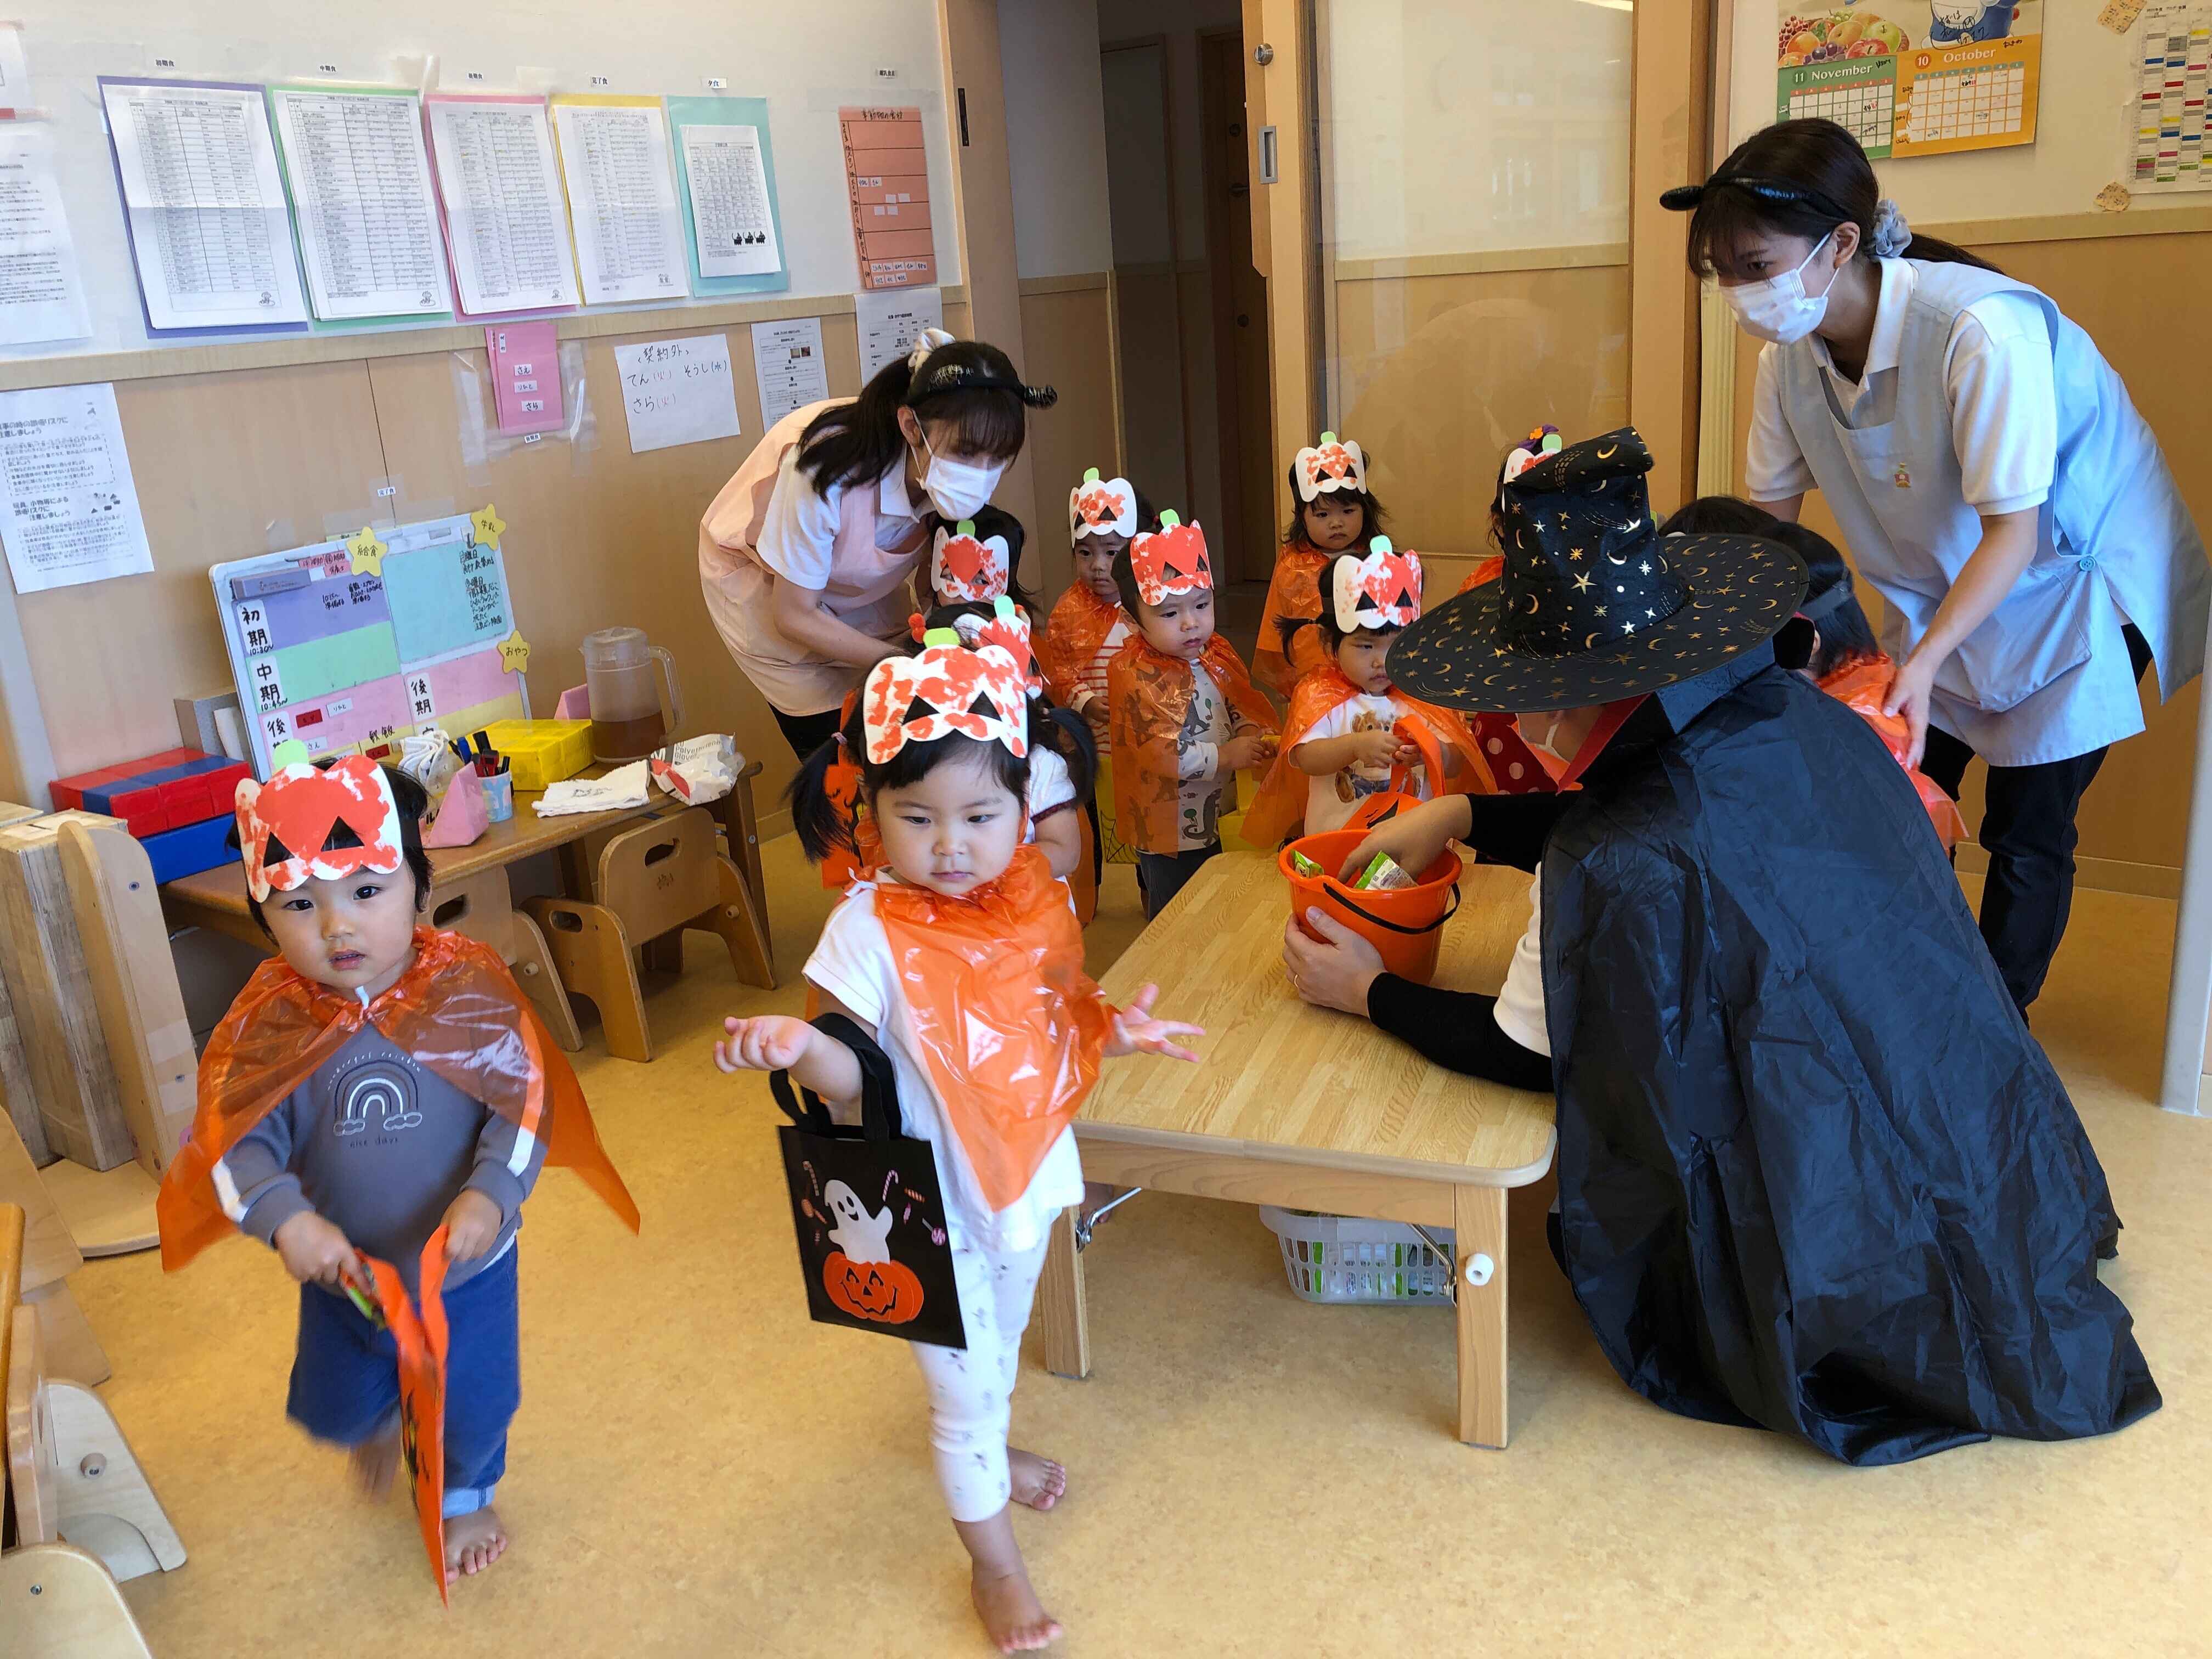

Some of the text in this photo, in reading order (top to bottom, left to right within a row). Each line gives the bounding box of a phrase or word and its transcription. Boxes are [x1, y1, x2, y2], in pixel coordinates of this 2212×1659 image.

[1917, 48, 1996, 66] 10 October
[1795, 65, 1873, 83] 11 November
[481, 519, 496, 532] 牛乳
[357, 544, 378, 558] 給食
[242, 607, 268, 647] 初期
[506, 646, 528, 657] おやつ
[257, 663, 280, 703] 中期
[411, 678, 432, 715] 後期
